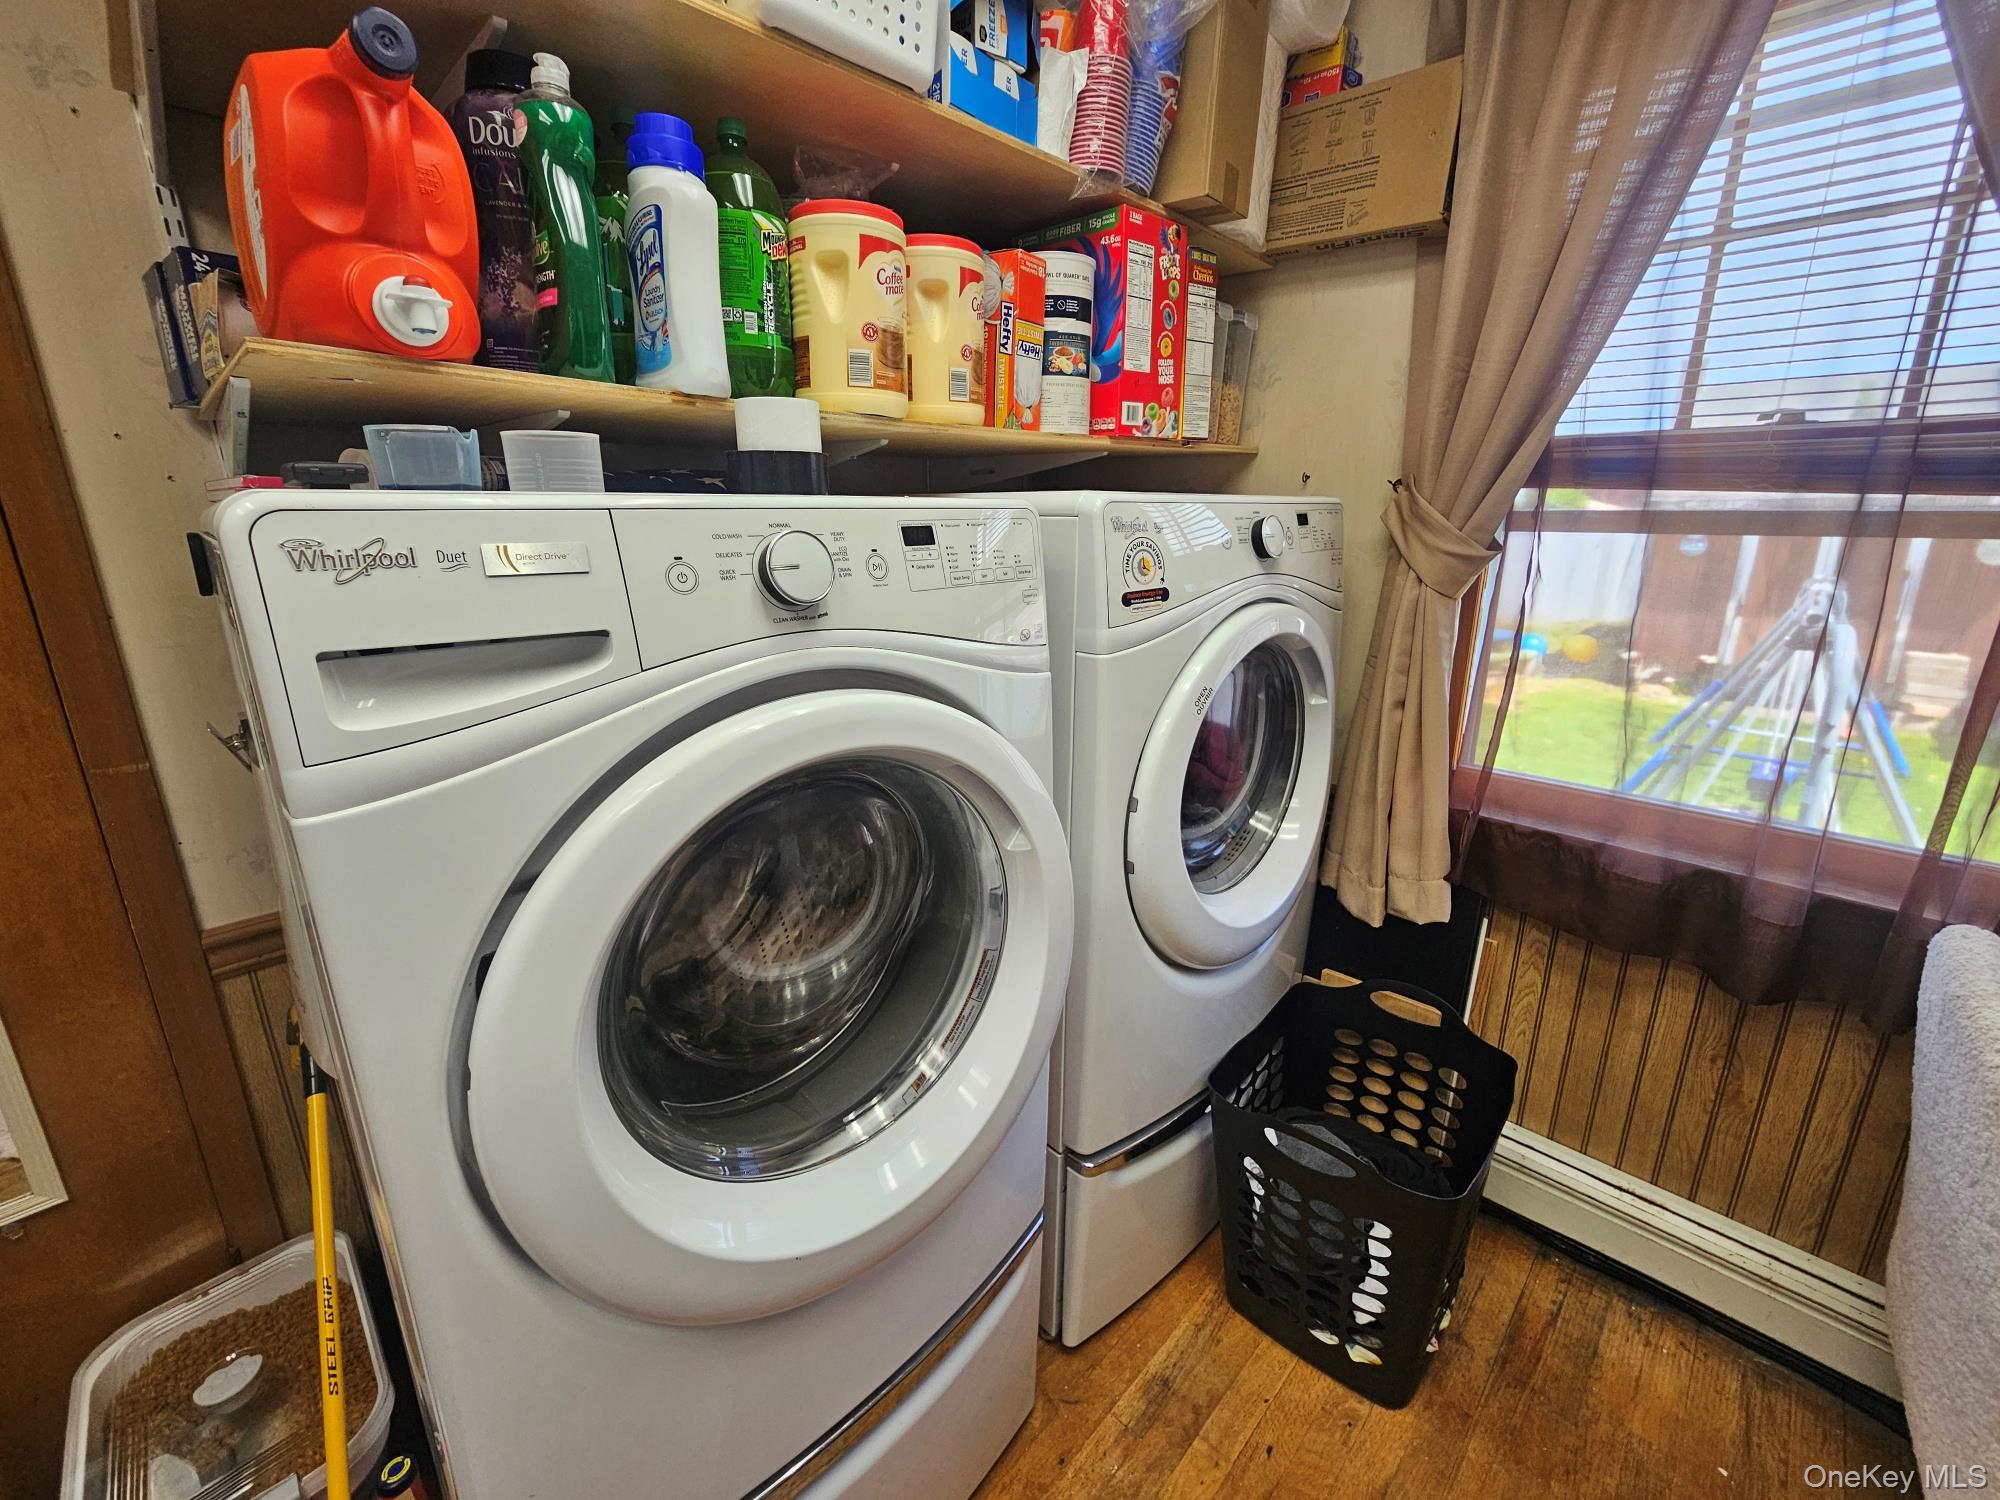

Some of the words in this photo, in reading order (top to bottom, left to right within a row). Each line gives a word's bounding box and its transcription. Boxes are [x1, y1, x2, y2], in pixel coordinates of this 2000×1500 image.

[472, 147, 517, 159] infusions
[1060, 222, 1081, 236] FIBER
[637, 229, 658, 275] Lysol
[876, 268, 903, 286] Coffee
[1161, 266, 1180, 280] LOOPS
[1193, 270, 1213, 284] Cheerios
[885, 284, 904, 296] mate
[643, 294, 664, 308] Sanitizer
[767, 281, 776, 334] RECYCLE
[1000, 304, 1013, 352] Hefty
[1018, 340, 1041, 358] Hefty
[1158, 366, 1174, 375] YOUR
[1158, 374, 1174, 384] NOSE
[1111, 519, 1149, 536] Whirlpool
[283, 544, 418, 578] Whirlpool
[436, 550, 468, 564] Duet
[515, 551, 542, 561] Direct
[544, 551, 567, 561] Drive
[1130, 540, 1145, 552] YOUR
[1145, 540, 1163, 570] SAVINGS
[789, 614, 808, 622] WASHER
[1195, 686, 1208, 707] OPEN
[1197, 687, 1214, 716] OUVRIR
[322, 1277, 334, 1324] GRIP
[325, 1328, 339, 1395] STEEL
